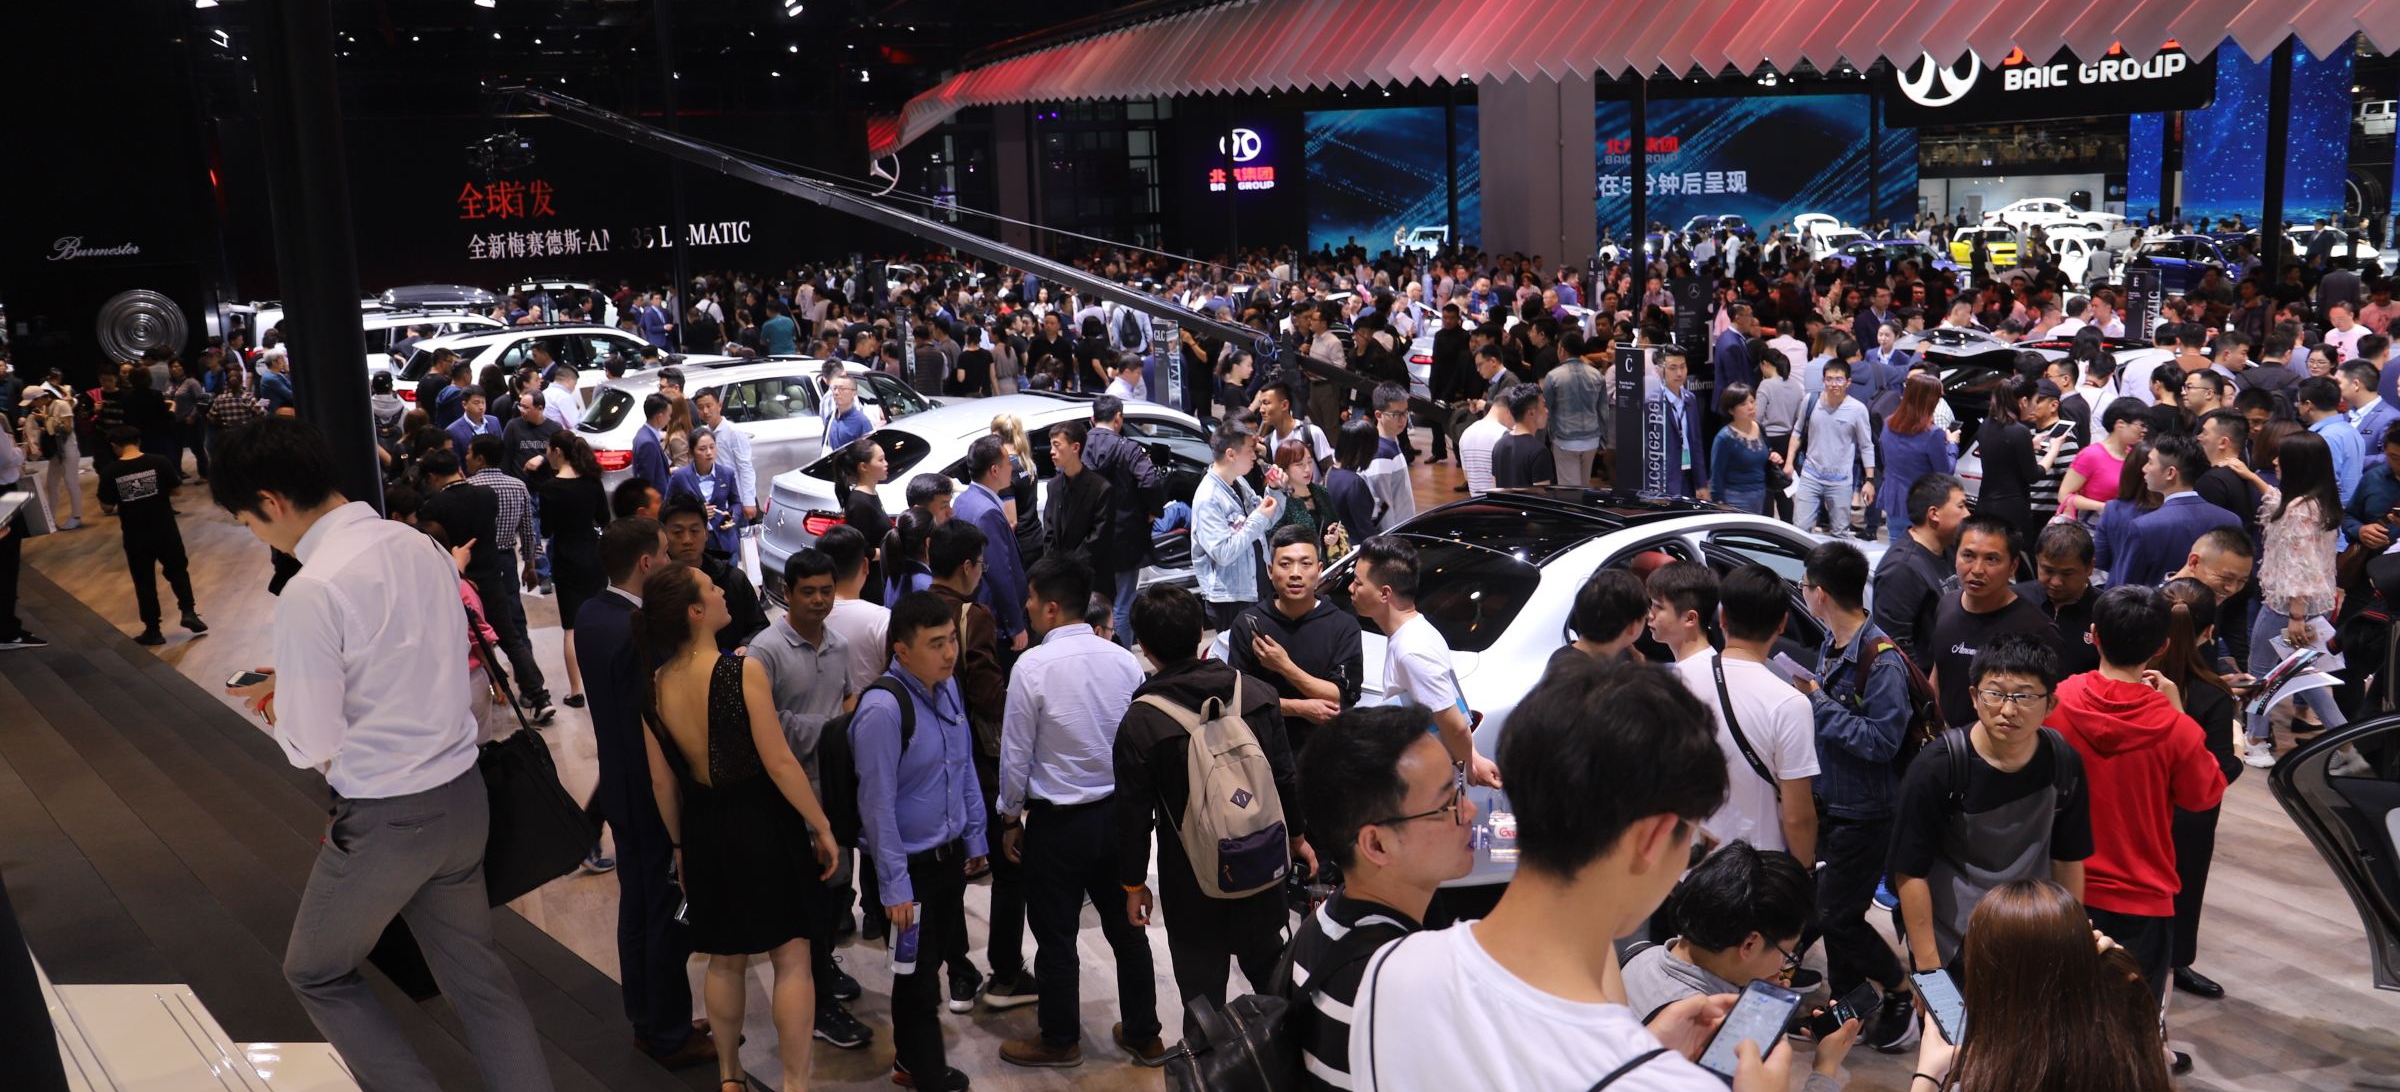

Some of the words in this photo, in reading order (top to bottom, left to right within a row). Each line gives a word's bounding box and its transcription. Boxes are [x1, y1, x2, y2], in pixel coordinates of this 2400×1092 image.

[2004, 64, 2069, 91] BAIC
[2078, 53, 2187, 84] GROUP
[1645, 153, 1679, 163] ROUP
[1237, 180, 1275, 190] GROUP
[458, 180, 556, 219] 全球首发
[685, 220, 752, 246] MATIC
[46, 236, 140, 261] Burmester
[1625, 357, 1633, 373] C
